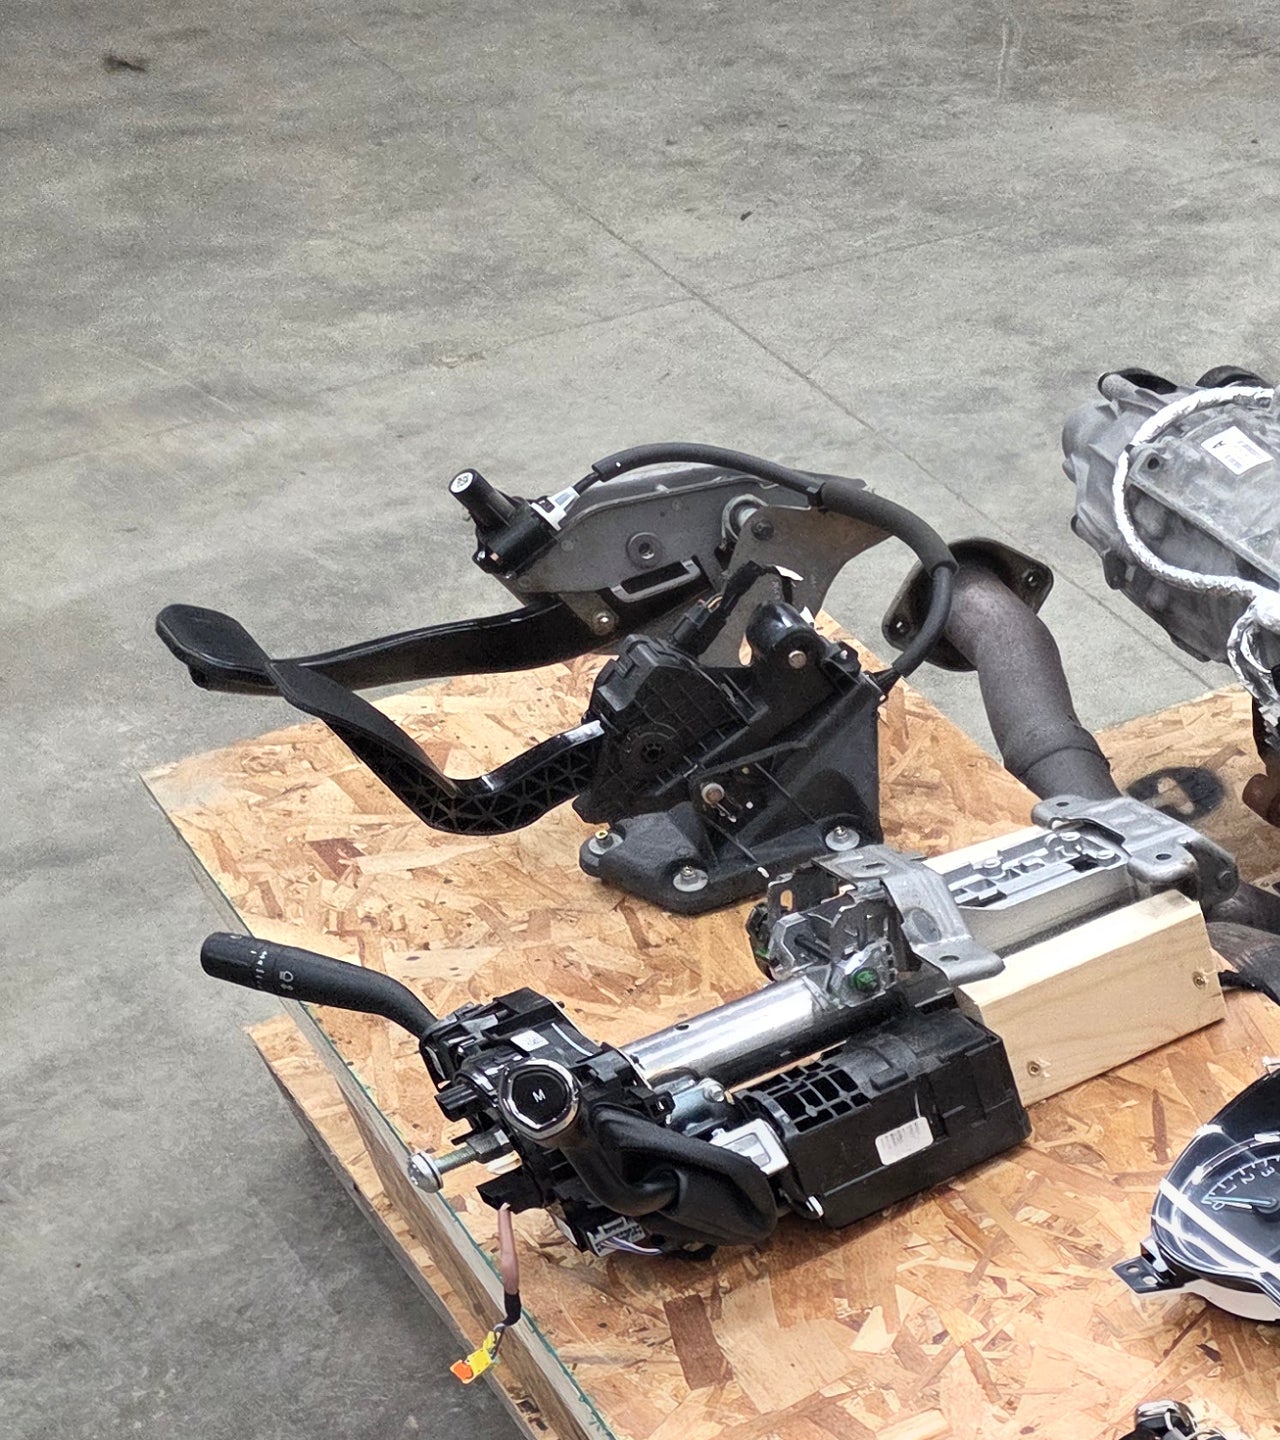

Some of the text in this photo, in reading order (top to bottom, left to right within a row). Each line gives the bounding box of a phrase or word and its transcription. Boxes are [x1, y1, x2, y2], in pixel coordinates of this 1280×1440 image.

[532, 1088, 546, 1103] M
[1225, 1184, 1237, 1195] 1
[1240, 1173, 1256, 1185] 2
[1261, 1166, 1275, 1177] 3
